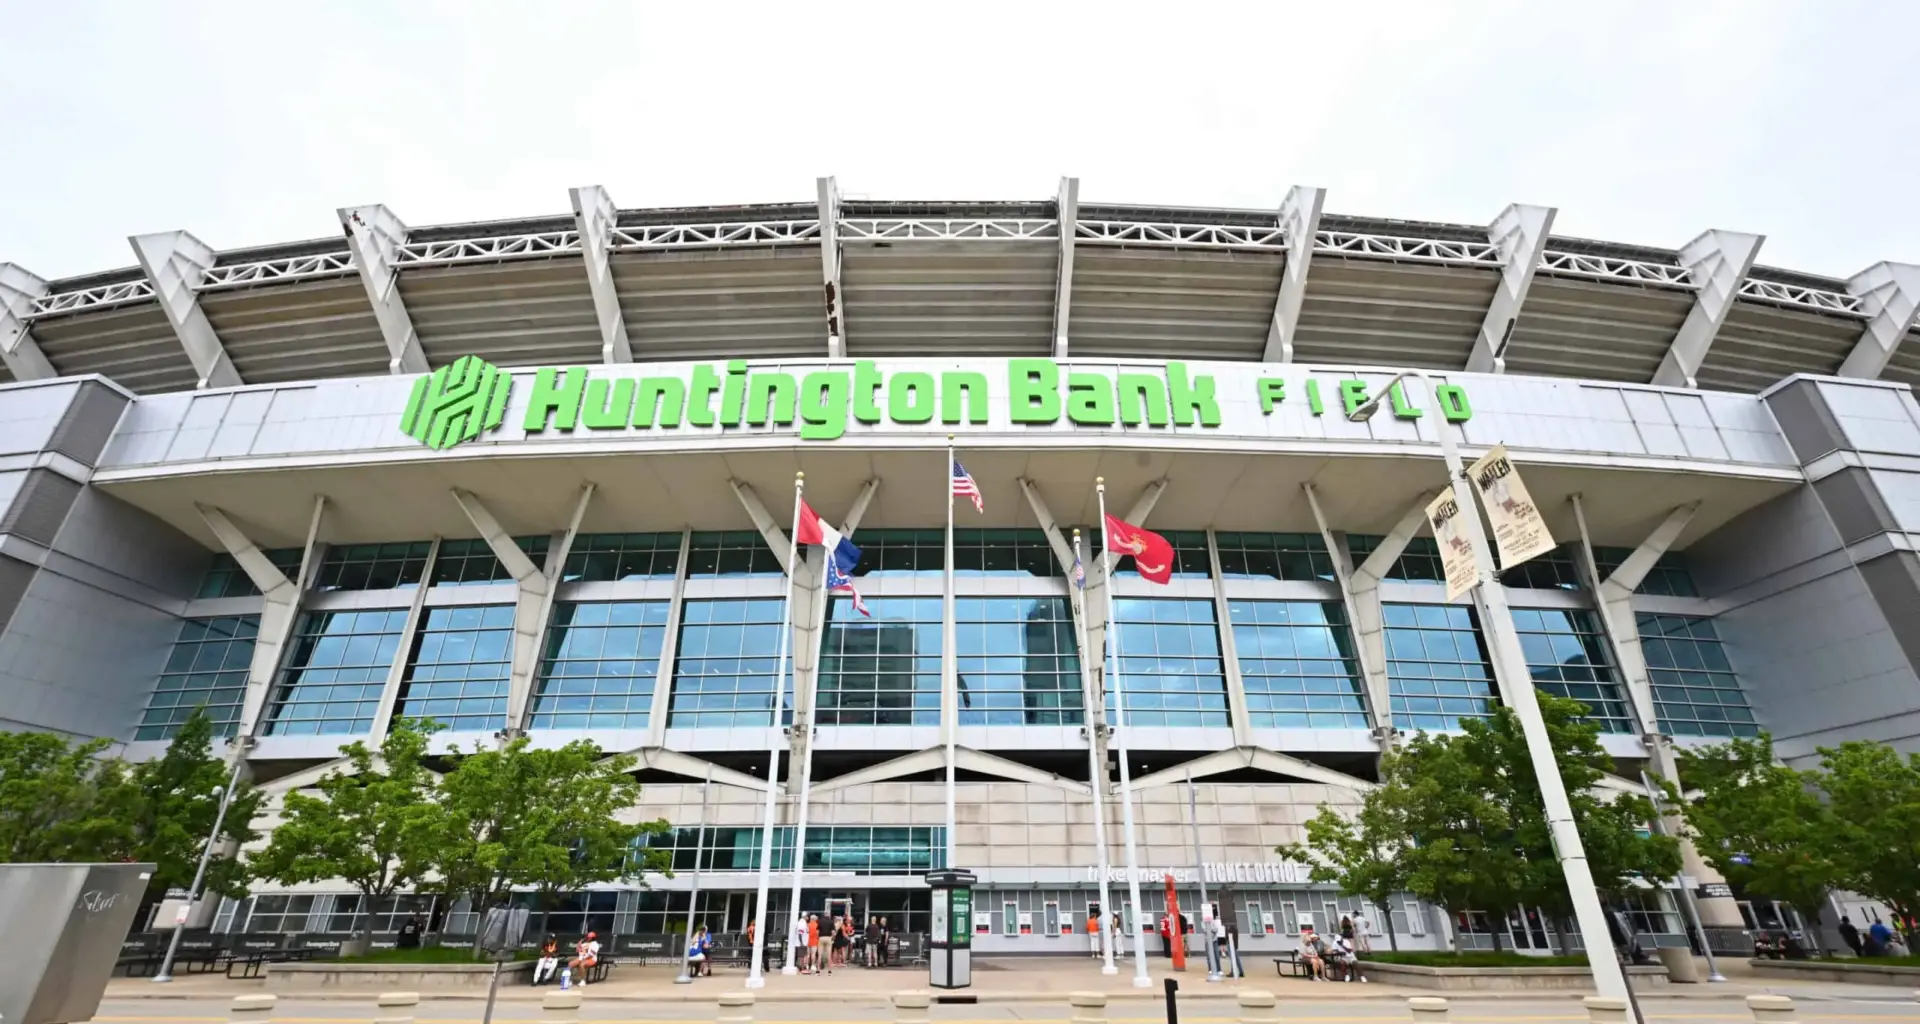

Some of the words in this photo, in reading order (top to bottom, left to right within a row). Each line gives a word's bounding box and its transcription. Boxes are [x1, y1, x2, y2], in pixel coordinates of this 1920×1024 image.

[523, 359, 989, 440] Huntington
[1008, 358, 1221, 426] Bank
[1257, 377, 1473, 422] FIELD
[1087, 863, 1189, 882] tikemaster
[1202, 862, 1249, 883] TICKET
